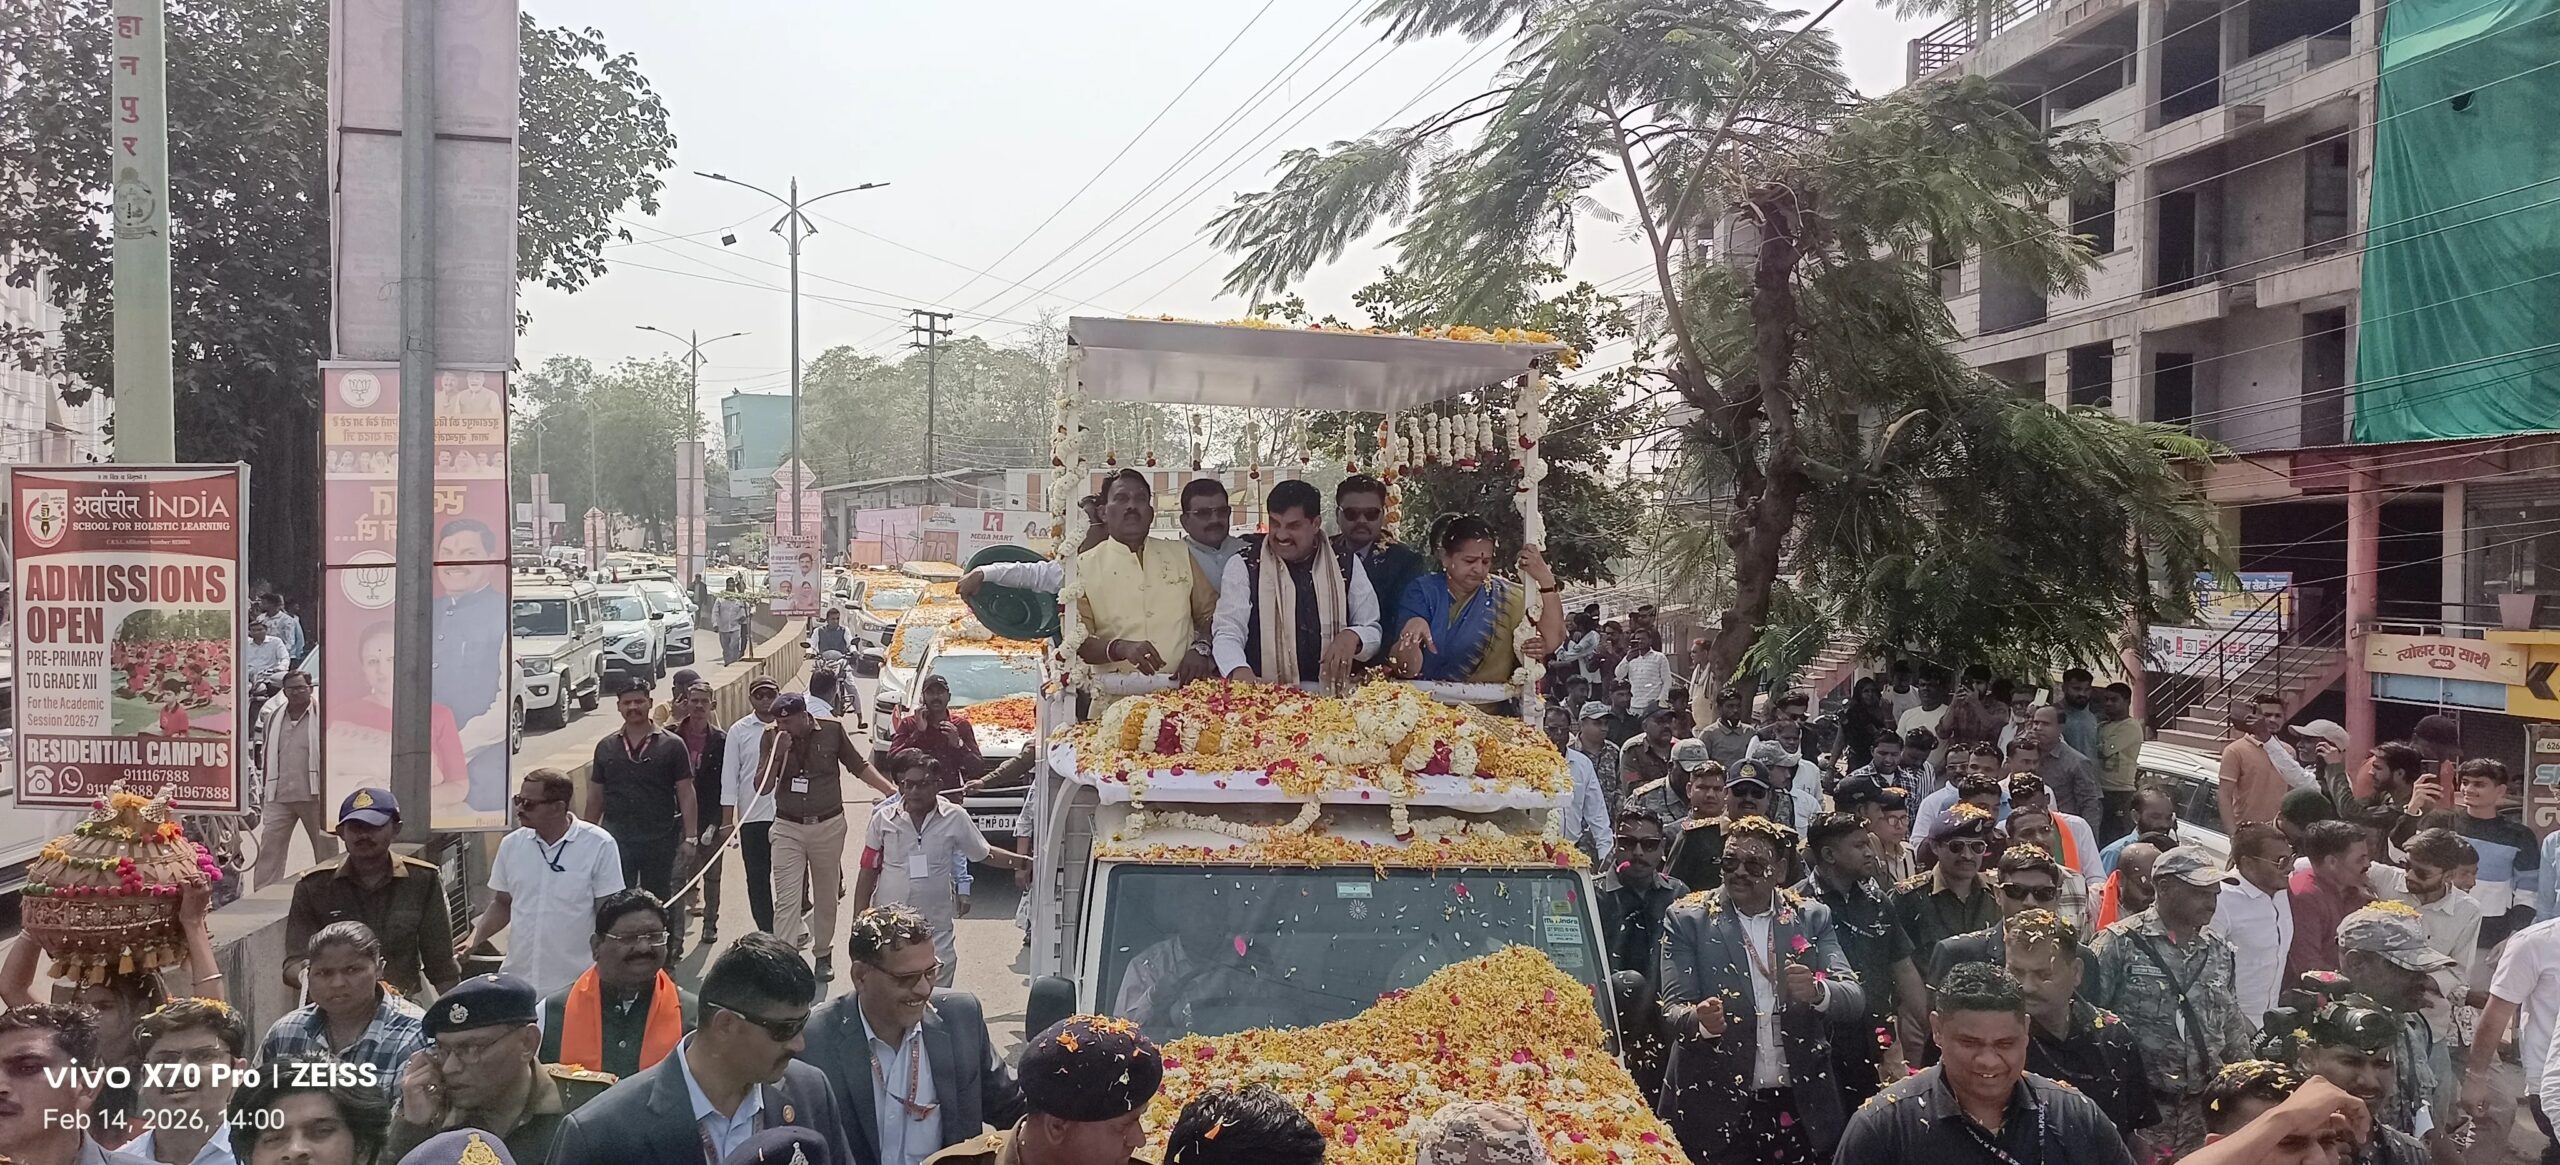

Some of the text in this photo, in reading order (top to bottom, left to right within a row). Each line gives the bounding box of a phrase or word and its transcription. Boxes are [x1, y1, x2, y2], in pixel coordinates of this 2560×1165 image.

[73, 488, 142, 519] अर्वाचीन
[72, 521, 230, 531] SCHOOL FOR HOLISTIC LEARNING
[970, 533, 1014, 542] MEGA MART
[26, 564, 226, 603] ADMISSIONS
[27, 606, 104, 644] OPEN
[2199, 640, 2247, 654] SHREE
[27, 650, 104, 667] PRE-PRIMARY
[2438, 644, 2456, 657] का
[2459, 647, 2491, 670] साथी
[27, 672, 97, 689] TO GRADE XII
[27, 696, 105, 710] For the Academic
[27, 713, 99, 727] Session 2026-27
[27, 738, 229, 768] RESIDENTIAL CAMPUS
[124, 768, 190, 782] 9111167888
